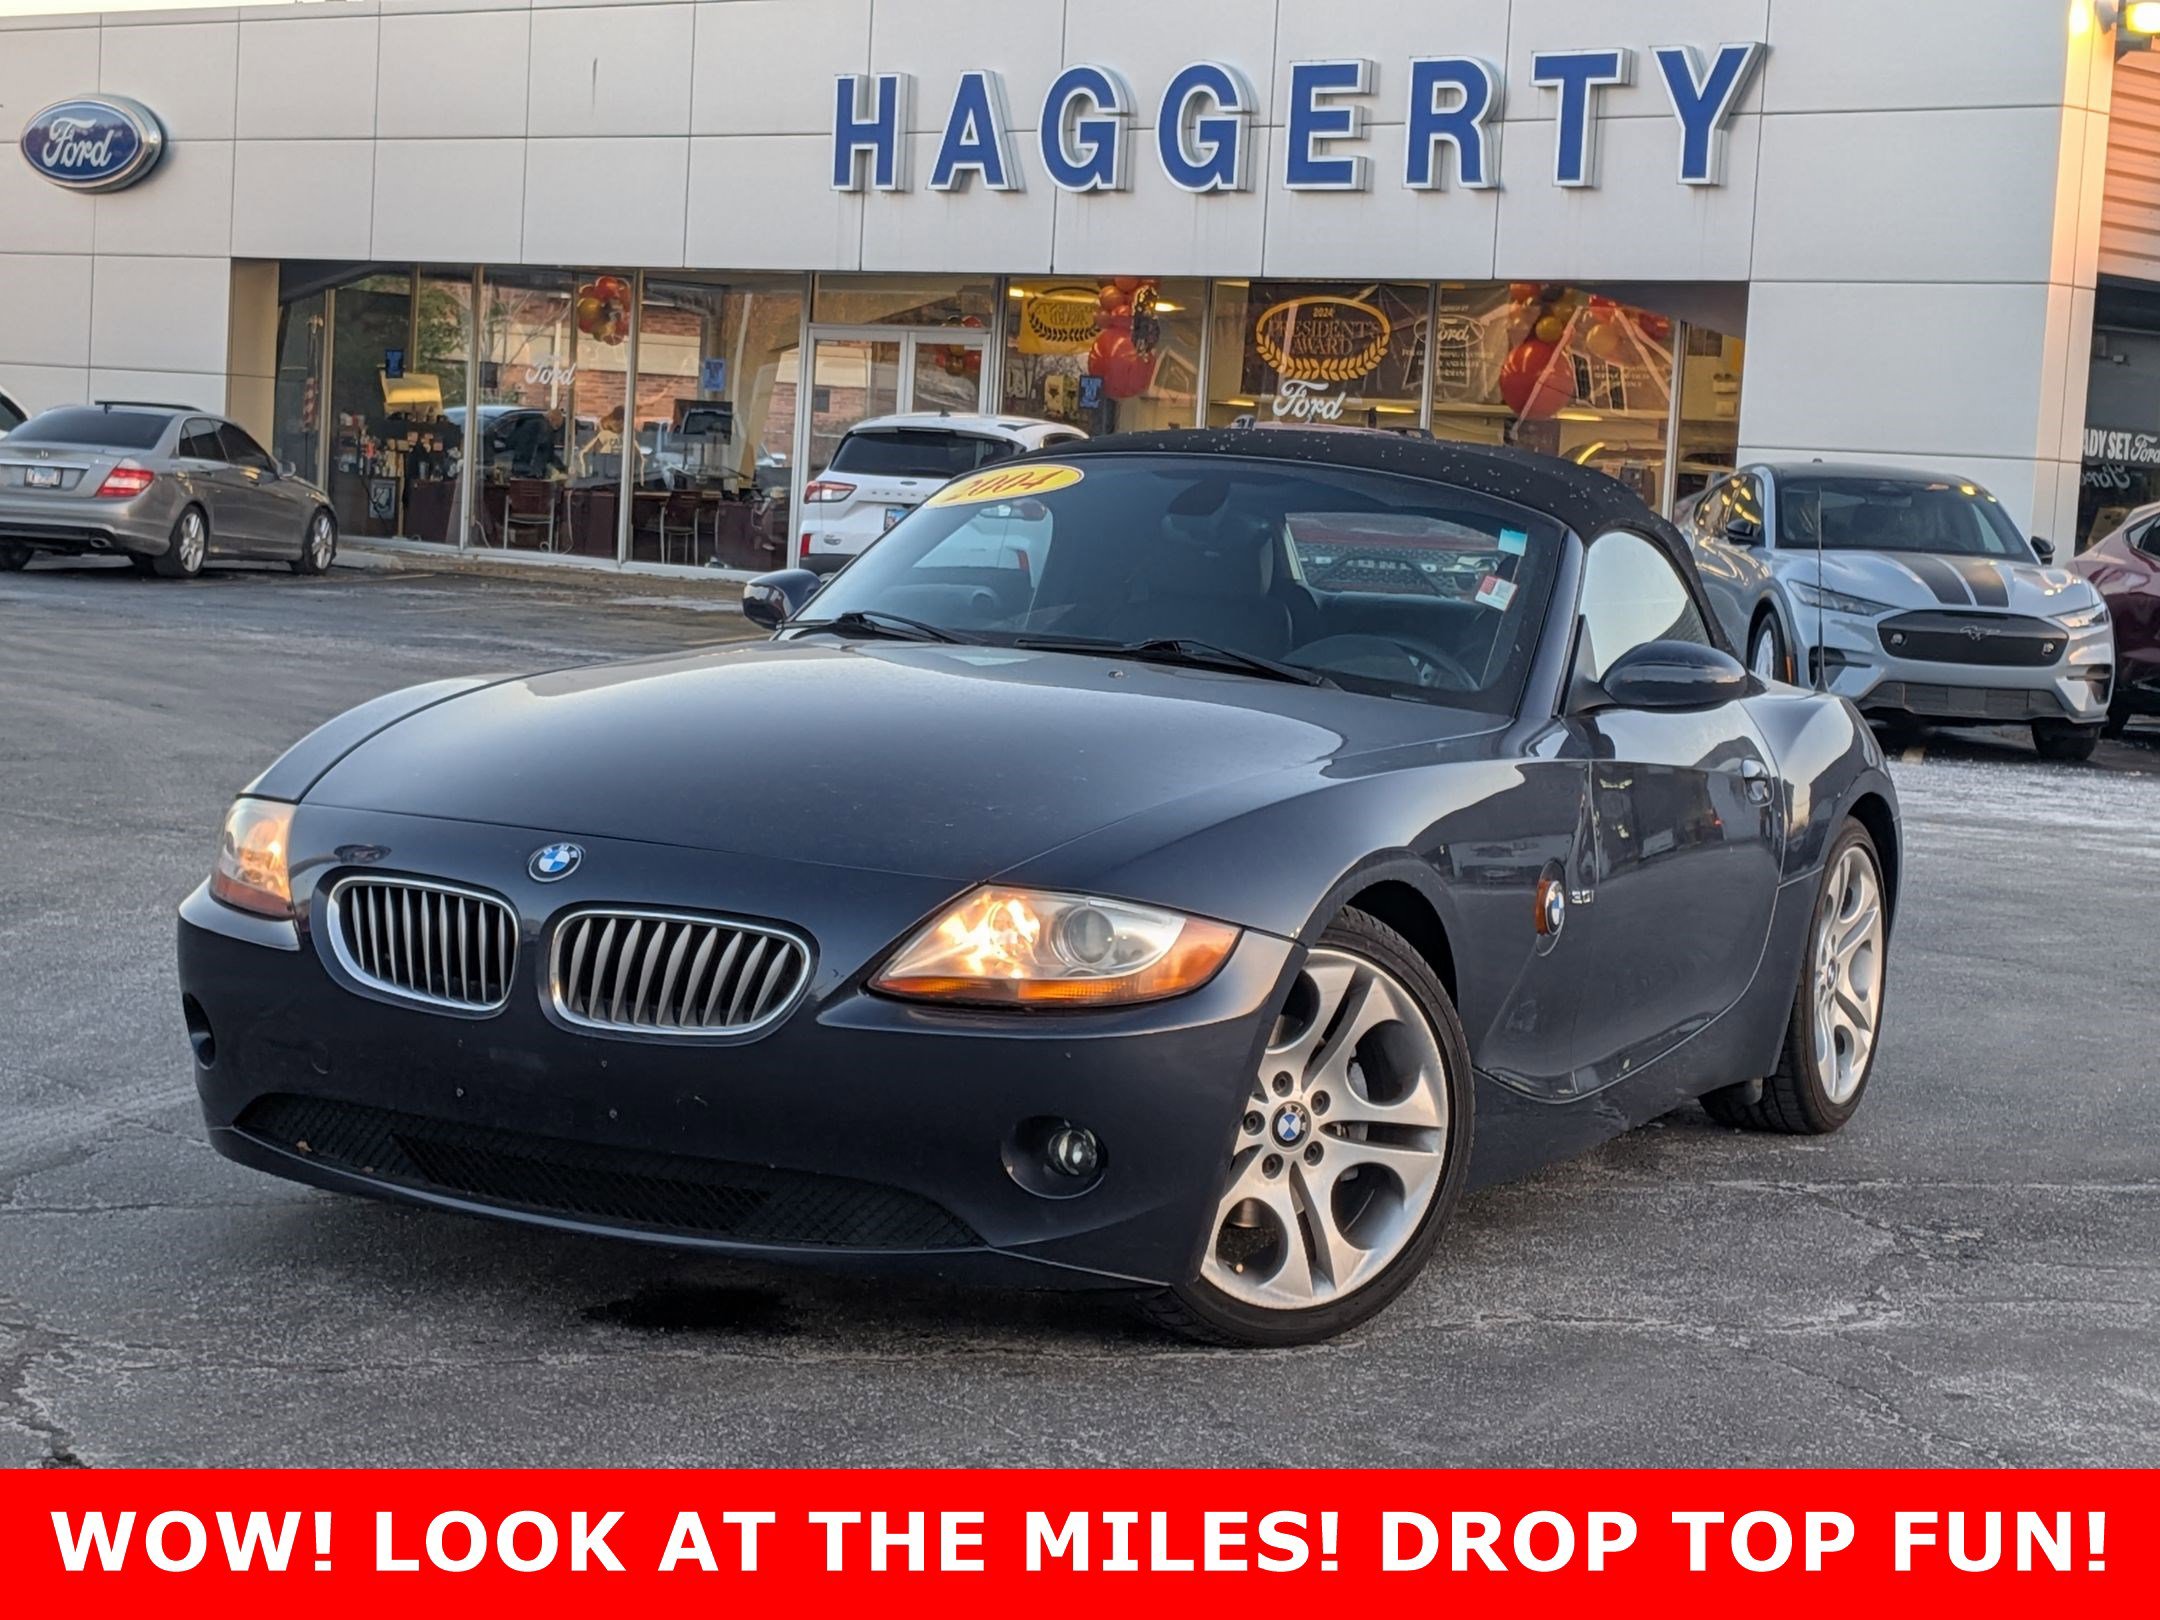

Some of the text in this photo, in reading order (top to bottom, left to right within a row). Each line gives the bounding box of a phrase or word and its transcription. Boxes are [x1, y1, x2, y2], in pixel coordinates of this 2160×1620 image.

[829, 42, 1763, 193] HAGGERTY
[42, 117, 114, 167] Ford
[1312, 307, 1335, 318] 2024
[1290, 336, 1354, 355] AWARD
[525, 356, 576, 386] Ford
[1272, 379, 1346, 420] Ford
[2107, 431, 2132, 461] SET
[945, 469, 1065, 501] 2004
